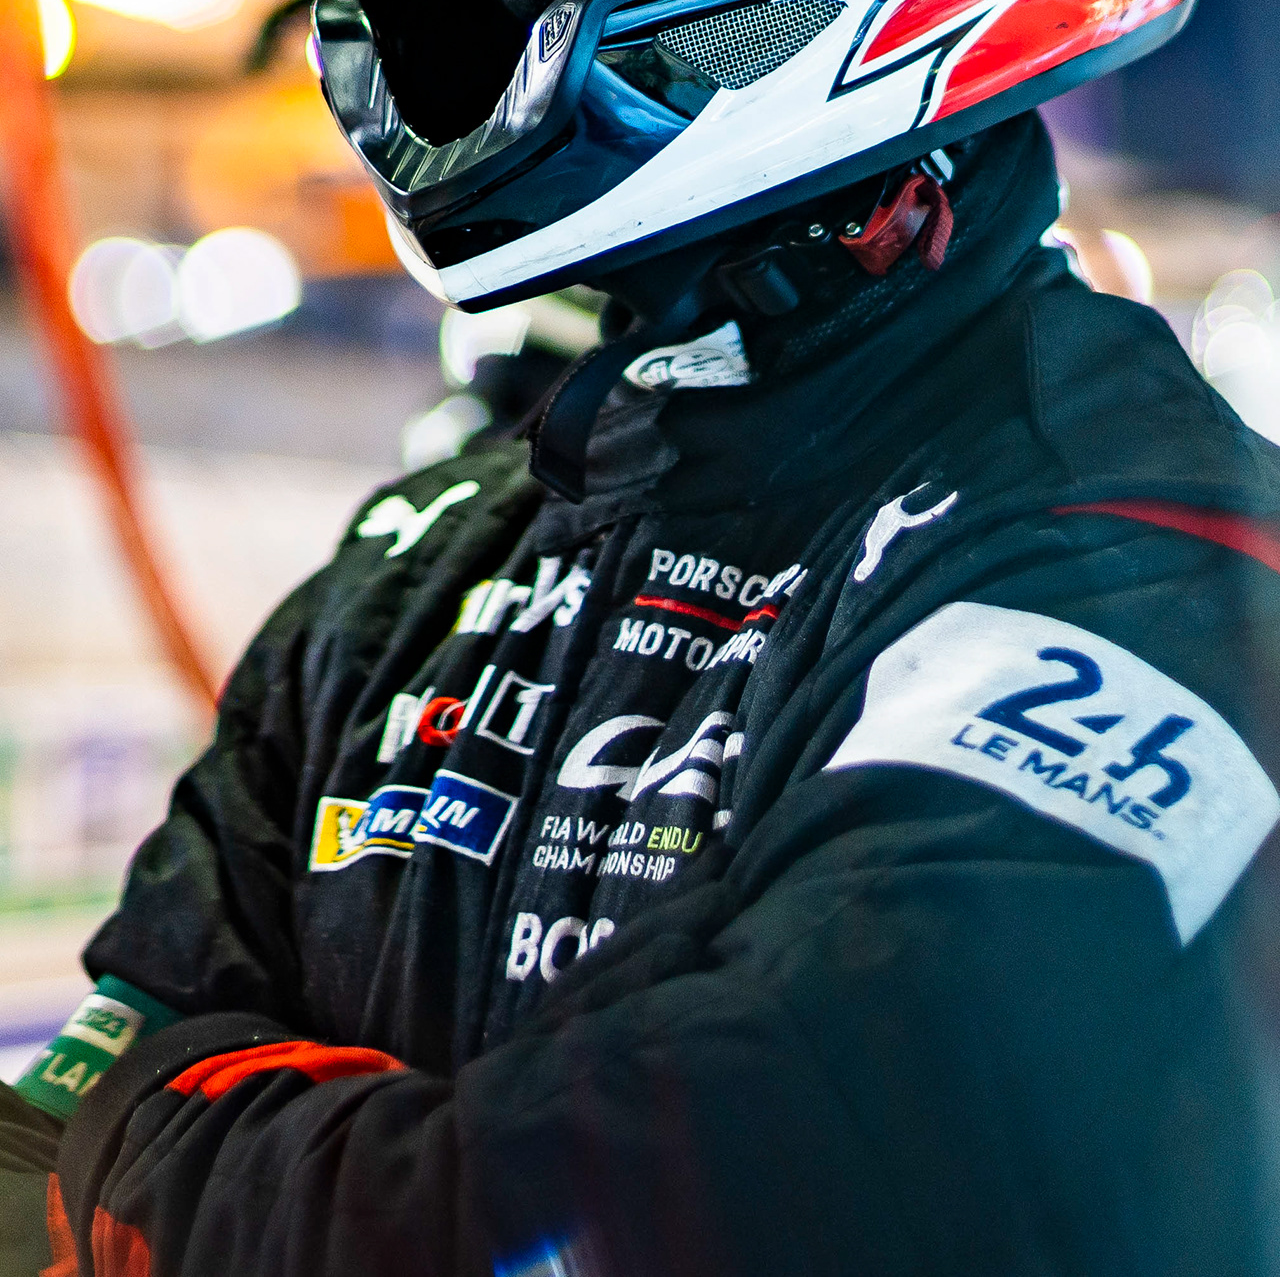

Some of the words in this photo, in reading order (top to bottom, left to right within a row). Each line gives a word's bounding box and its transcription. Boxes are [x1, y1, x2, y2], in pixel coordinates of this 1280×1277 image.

[950, 723, 1020, 762] LE
[1017, 747, 1160, 830] MANS
[540, 814, 571, 841] FIA
